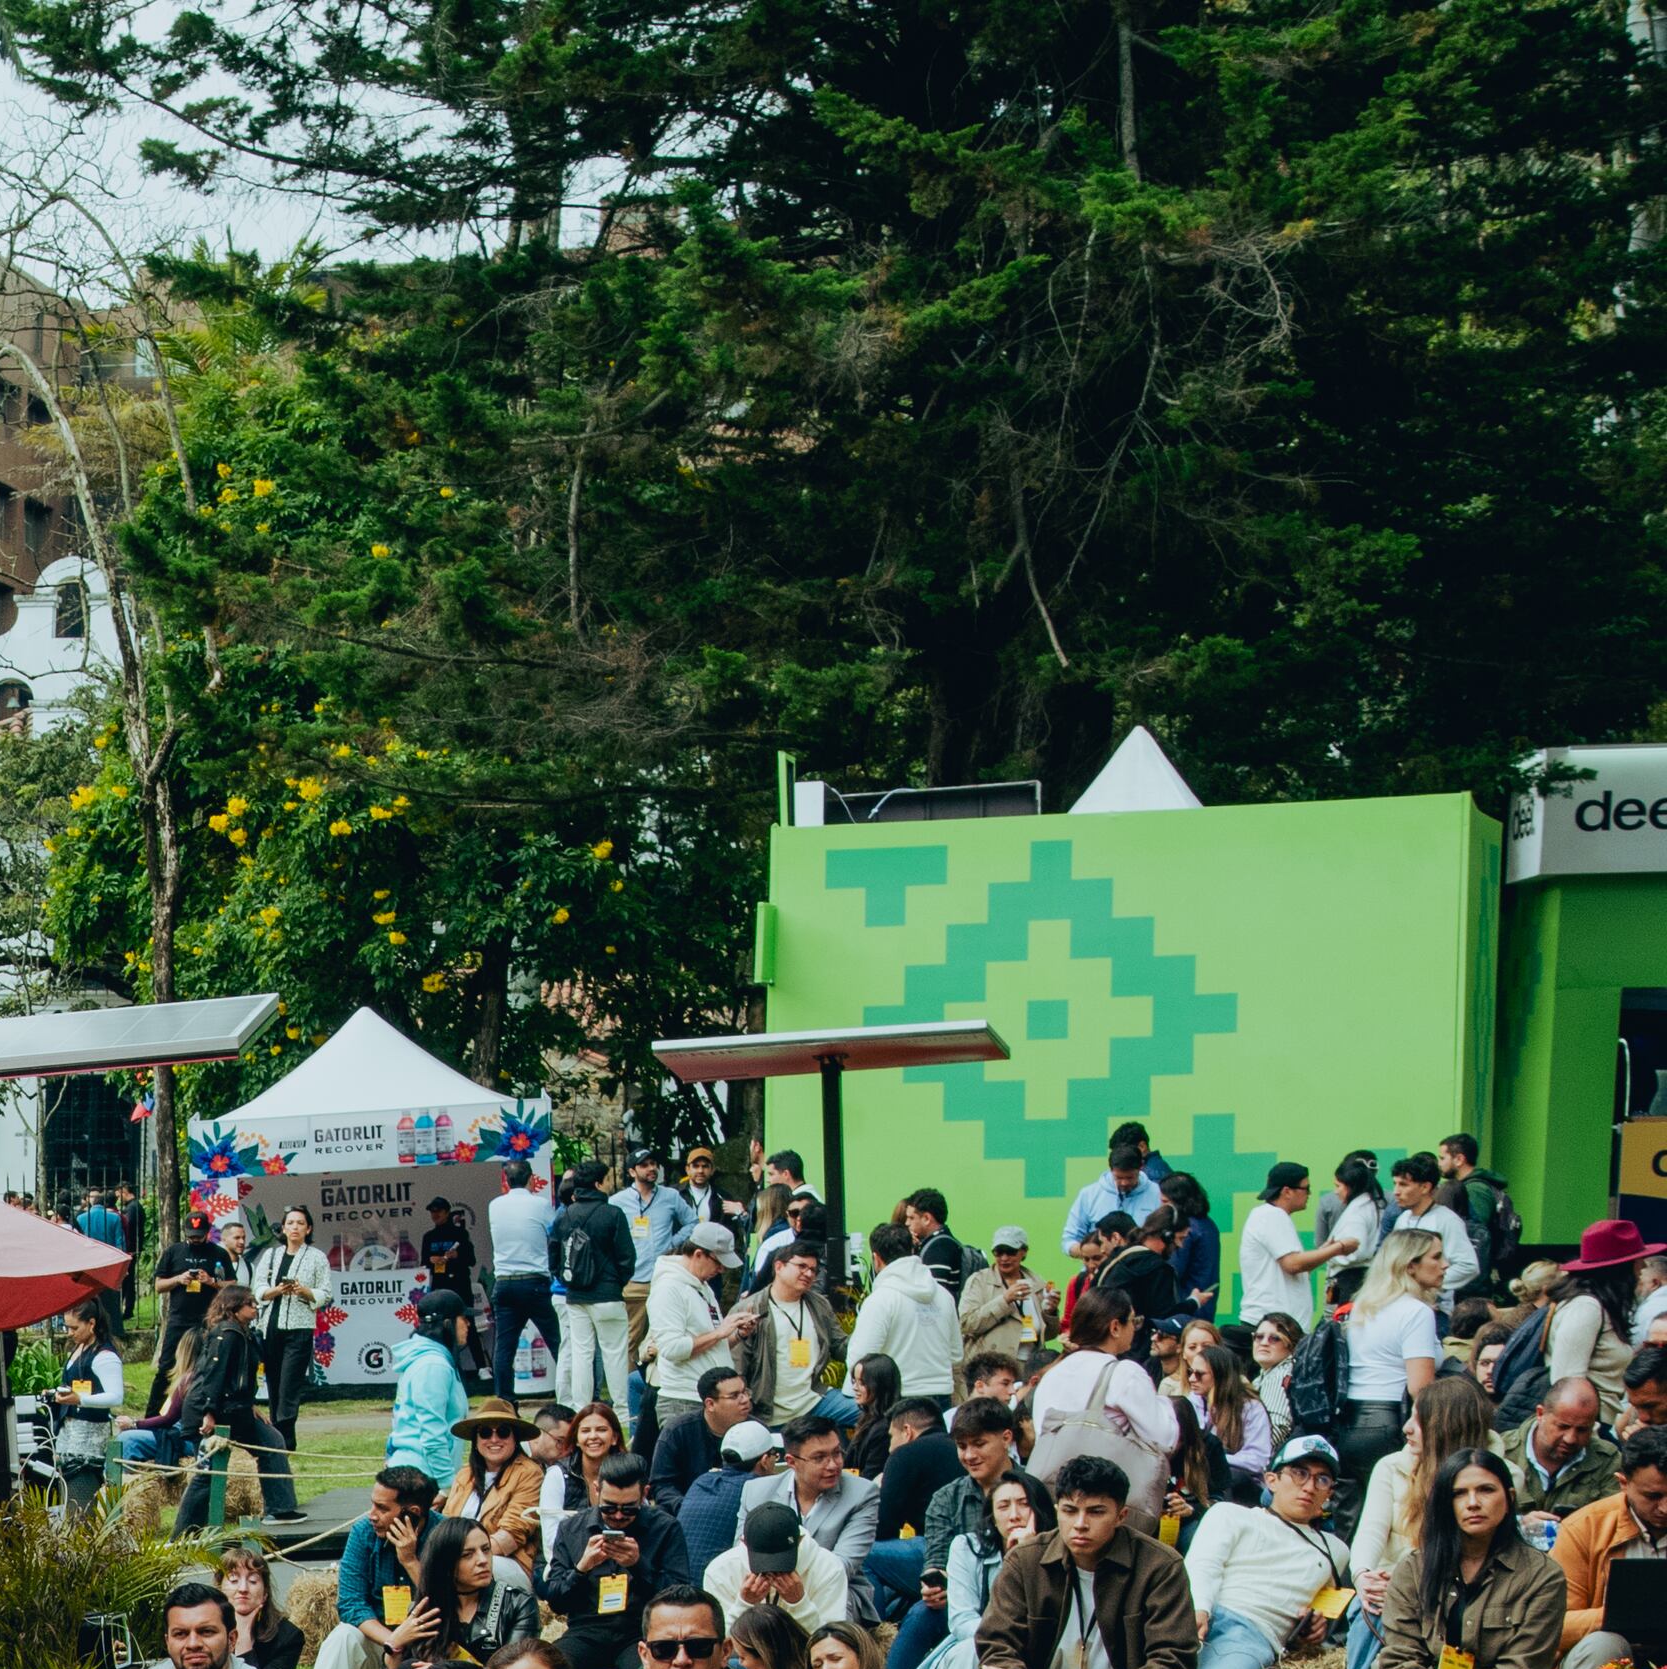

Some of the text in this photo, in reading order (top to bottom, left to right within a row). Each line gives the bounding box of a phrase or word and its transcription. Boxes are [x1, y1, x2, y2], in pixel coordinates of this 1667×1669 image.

[315, 1125, 383, 1142] GATORLIT
[315, 1143, 384, 1155] RECOVER
[321, 1182, 412, 1207] GATORLIT
[322, 1207, 413, 1222] RECOVER
[340, 1280, 403, 1296] GATORLIT
[340, 1297, 404, 1306] RECOVER
